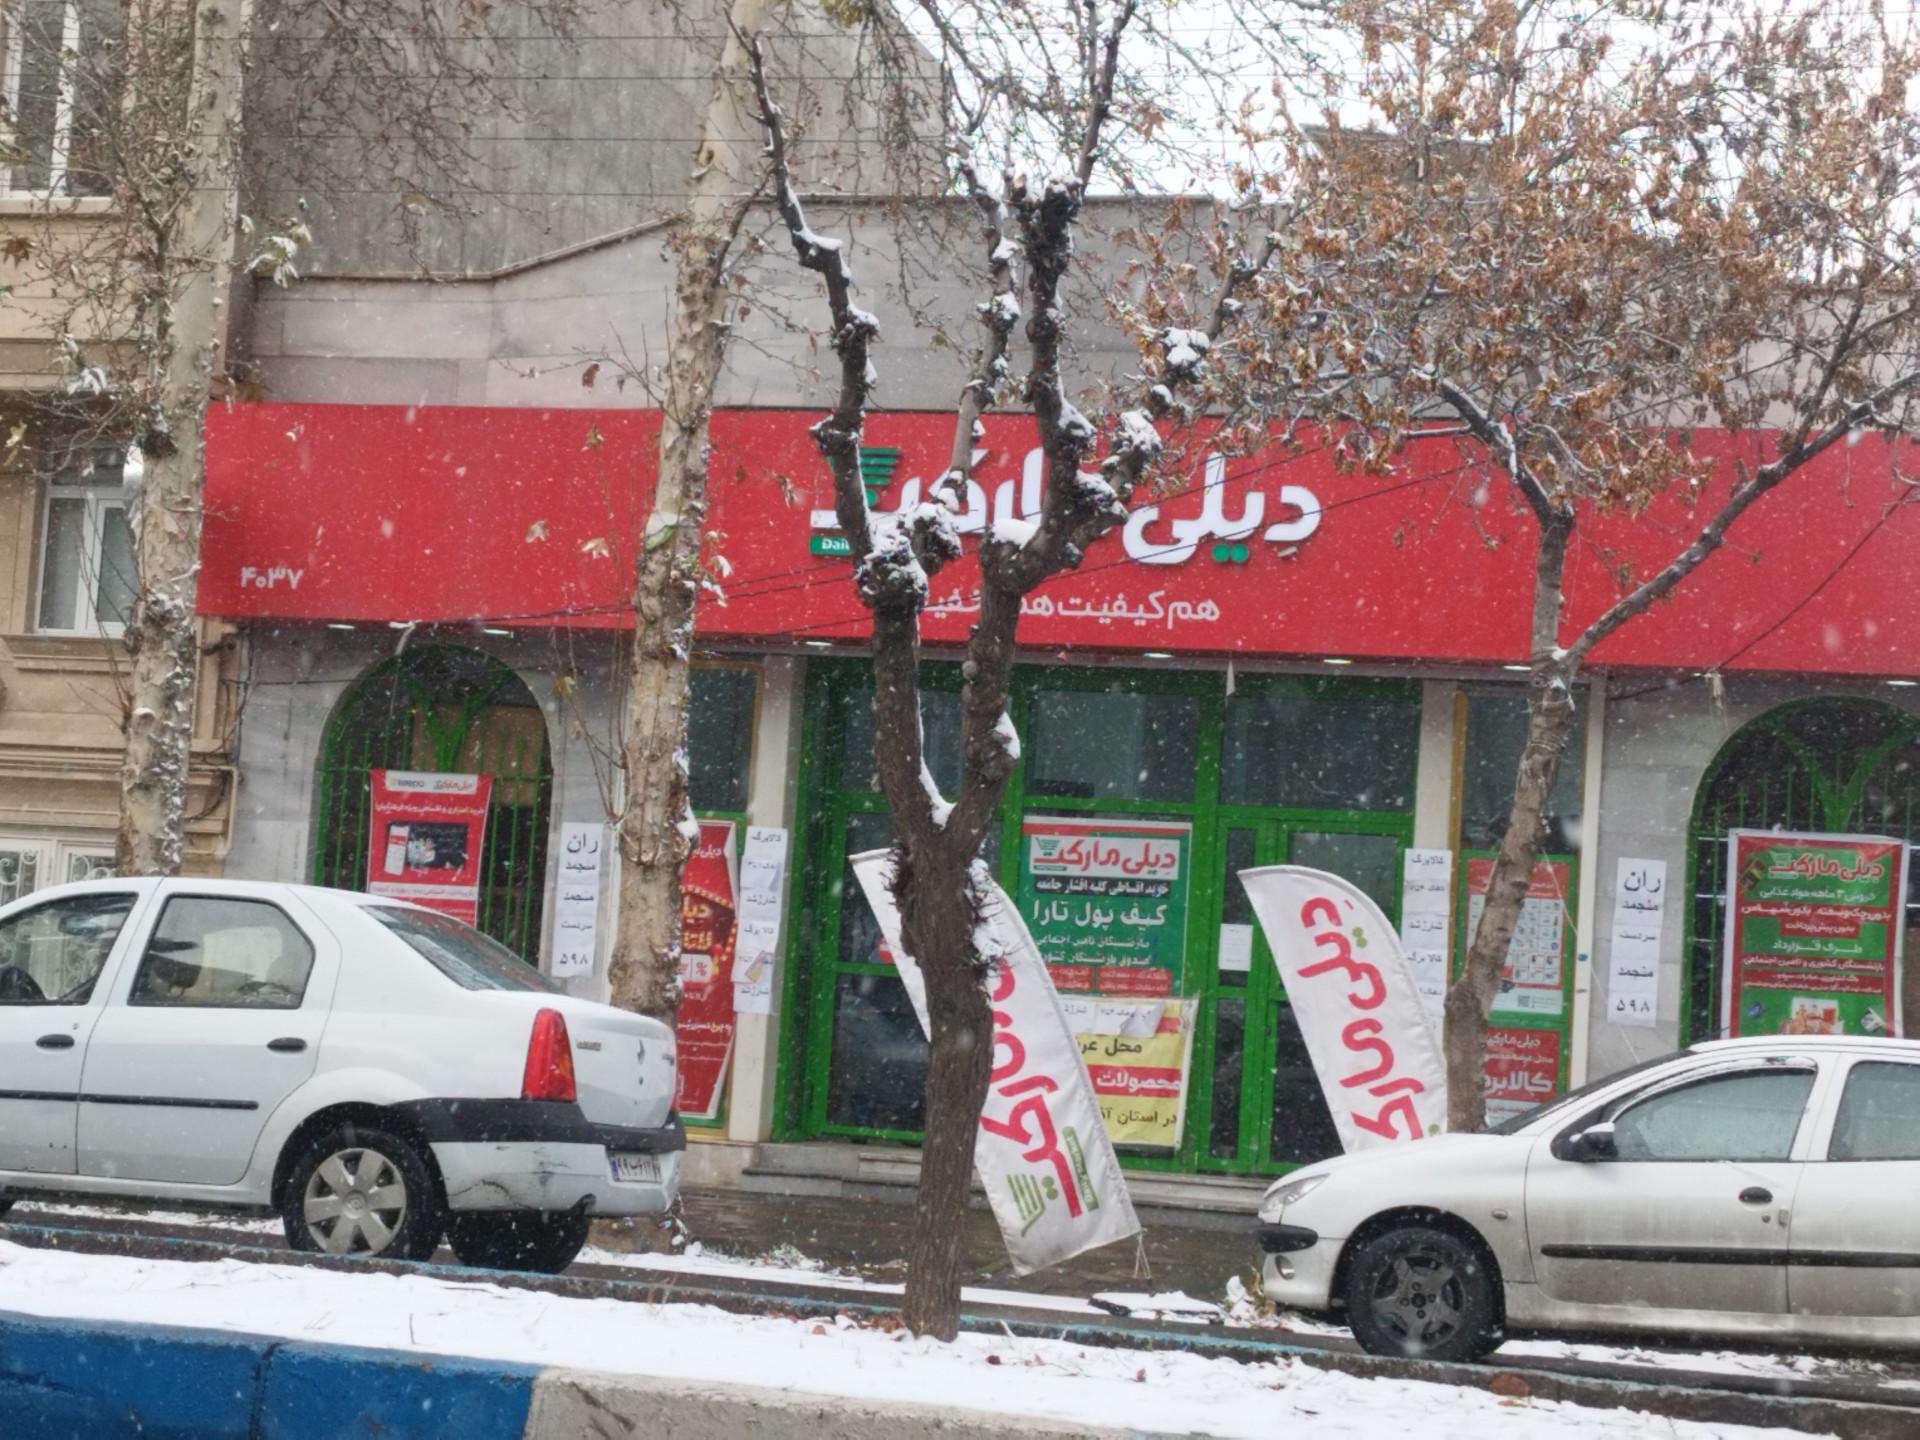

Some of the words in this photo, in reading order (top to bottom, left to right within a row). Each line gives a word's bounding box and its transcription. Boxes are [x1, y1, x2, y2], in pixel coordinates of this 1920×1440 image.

[810, 446, 1045, 534] ارکت
[1123, 452, 1322, 565] دیلی
[821, 538, 850, 550] Dail
[240, 566, 304, 590] ۴۰۳۷
[1057, 590, 1166, 624] کیفیت
[1166, 598, 1221, 629] هم
[566, 832, 599, 854] ران
[1033, 837, 1121, 872] مارکت
[1121, 841, 1177, 875] دیلی
[1623, 868, 1662, 894] ران
[1033, 899, 1070, 926] تارا
[1075, 900, 1114, 931] پول
[1119, 902, 1168, 931] کیف
[559, 953, 588, 965] ۵۹۸
[1297, 896, 1387, 1010] دیلی
[1615, 999, 1651, 1013] ۵۹۸
[1105, 1037, 1143, 1057] محل
[1096, 1069, 1182, 1093] محصولات
[1339, 1017, 1426, 1141] مارک
[1117, 1110, 1158, 1126] استان
